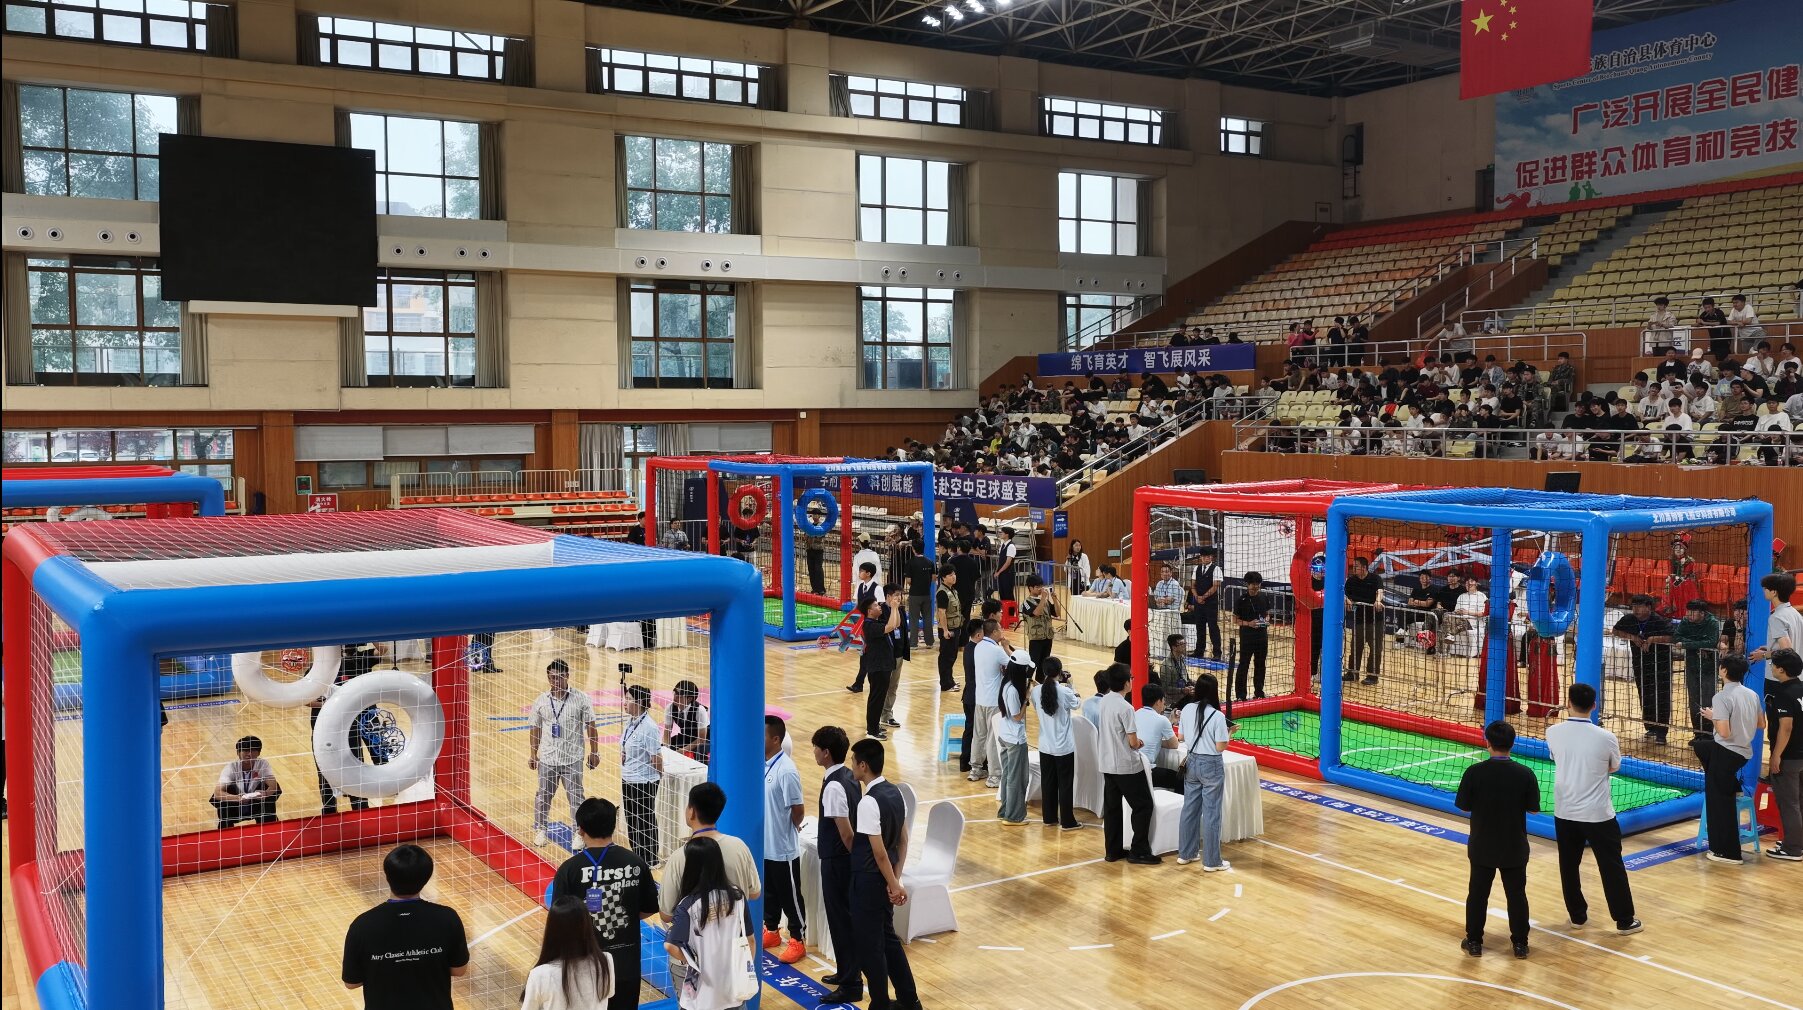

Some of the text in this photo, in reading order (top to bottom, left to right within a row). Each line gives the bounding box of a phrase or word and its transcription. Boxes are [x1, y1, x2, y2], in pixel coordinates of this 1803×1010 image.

[1588, 31, 1716, 72] 族自治县体育中心
[1572, 64, 1800, 135] 广泛开展全民健
[1516, 118, 1798, 189] 促进群众体育和竞技
[1071, 348, 1211, 371] 绵飞育英才 智飞展风采
[868, 474, 914, 493] 科创赋能
[581, 864, 633, 884] First
[611, 878, 640, 894] place
[430, 946, 443, 954] Club
